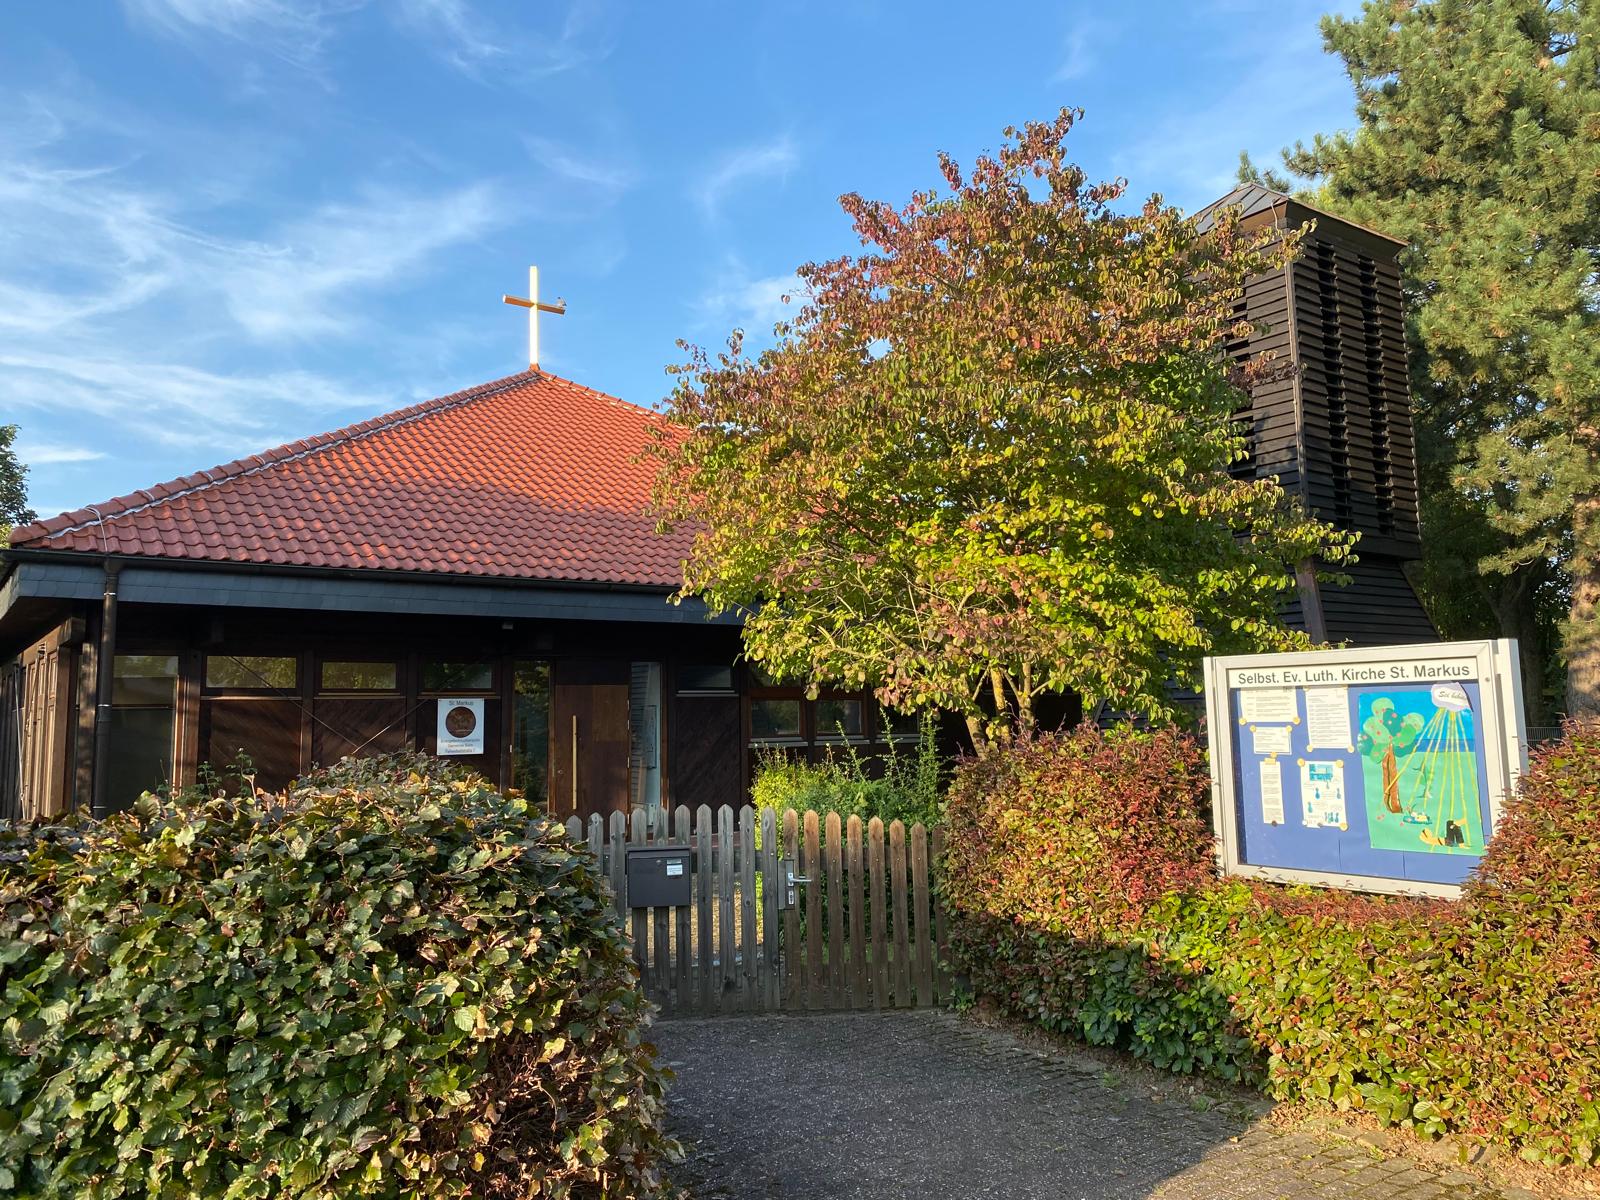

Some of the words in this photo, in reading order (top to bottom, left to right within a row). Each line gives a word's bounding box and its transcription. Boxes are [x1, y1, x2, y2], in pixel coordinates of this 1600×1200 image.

[1238, 672, 1279, 684] Selbst.
[1283, 671, 1301, 683] Ev.
[1305, 670, 1338, 682] Luth.
[1341, 668, 1386, 681] Kirche
[1390, 666, 1409, 679] St.
[1414, 664, 1470, 677] Markus
